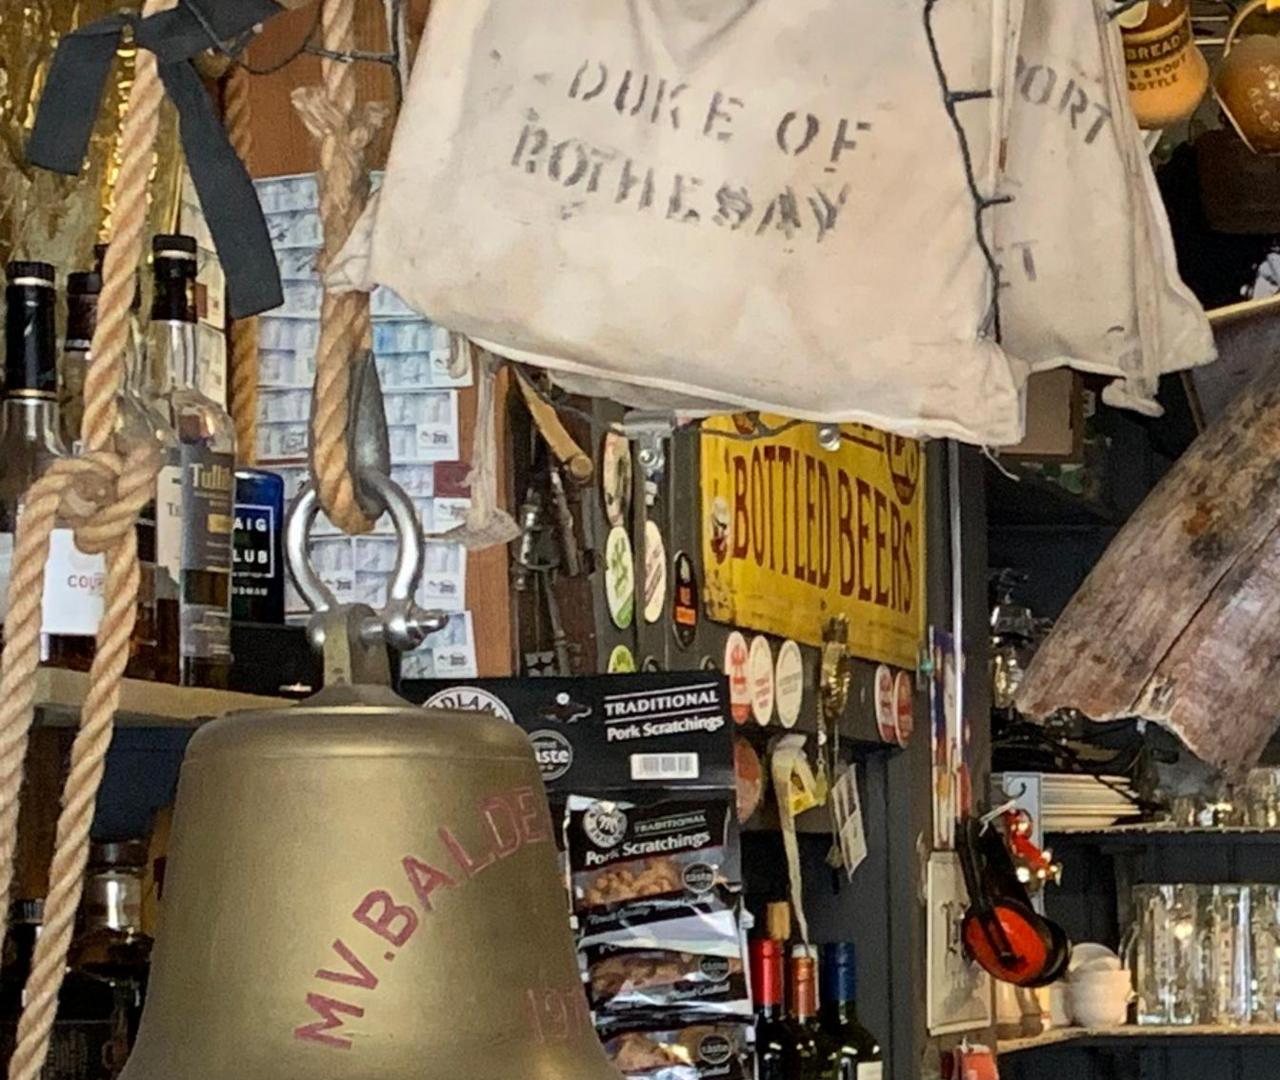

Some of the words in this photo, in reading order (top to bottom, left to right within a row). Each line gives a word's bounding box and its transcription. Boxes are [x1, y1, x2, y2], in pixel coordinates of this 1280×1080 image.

[1126, 35, 1180, 60] BREAD
[567, 58, 745, 143] DUKE
[774, 110, 874, 165] OF
[510, 120, 853, 244] ROTHESAY
[232, 517, 268, 532] AIG
[731, 443, 833, 590] BOTTLED
[838, 463, 914, 618] BEERS
[232, 549, 268, 564] LUB
[604, 689, 720, 717] TRADITIONAL
[606, 726, 641, 742] Pork
[642, 715, 725, 737] Scratchings
[634, 814, 707, 833] TRADITIONAL
[621, 831, 711, 856] Scratchings
